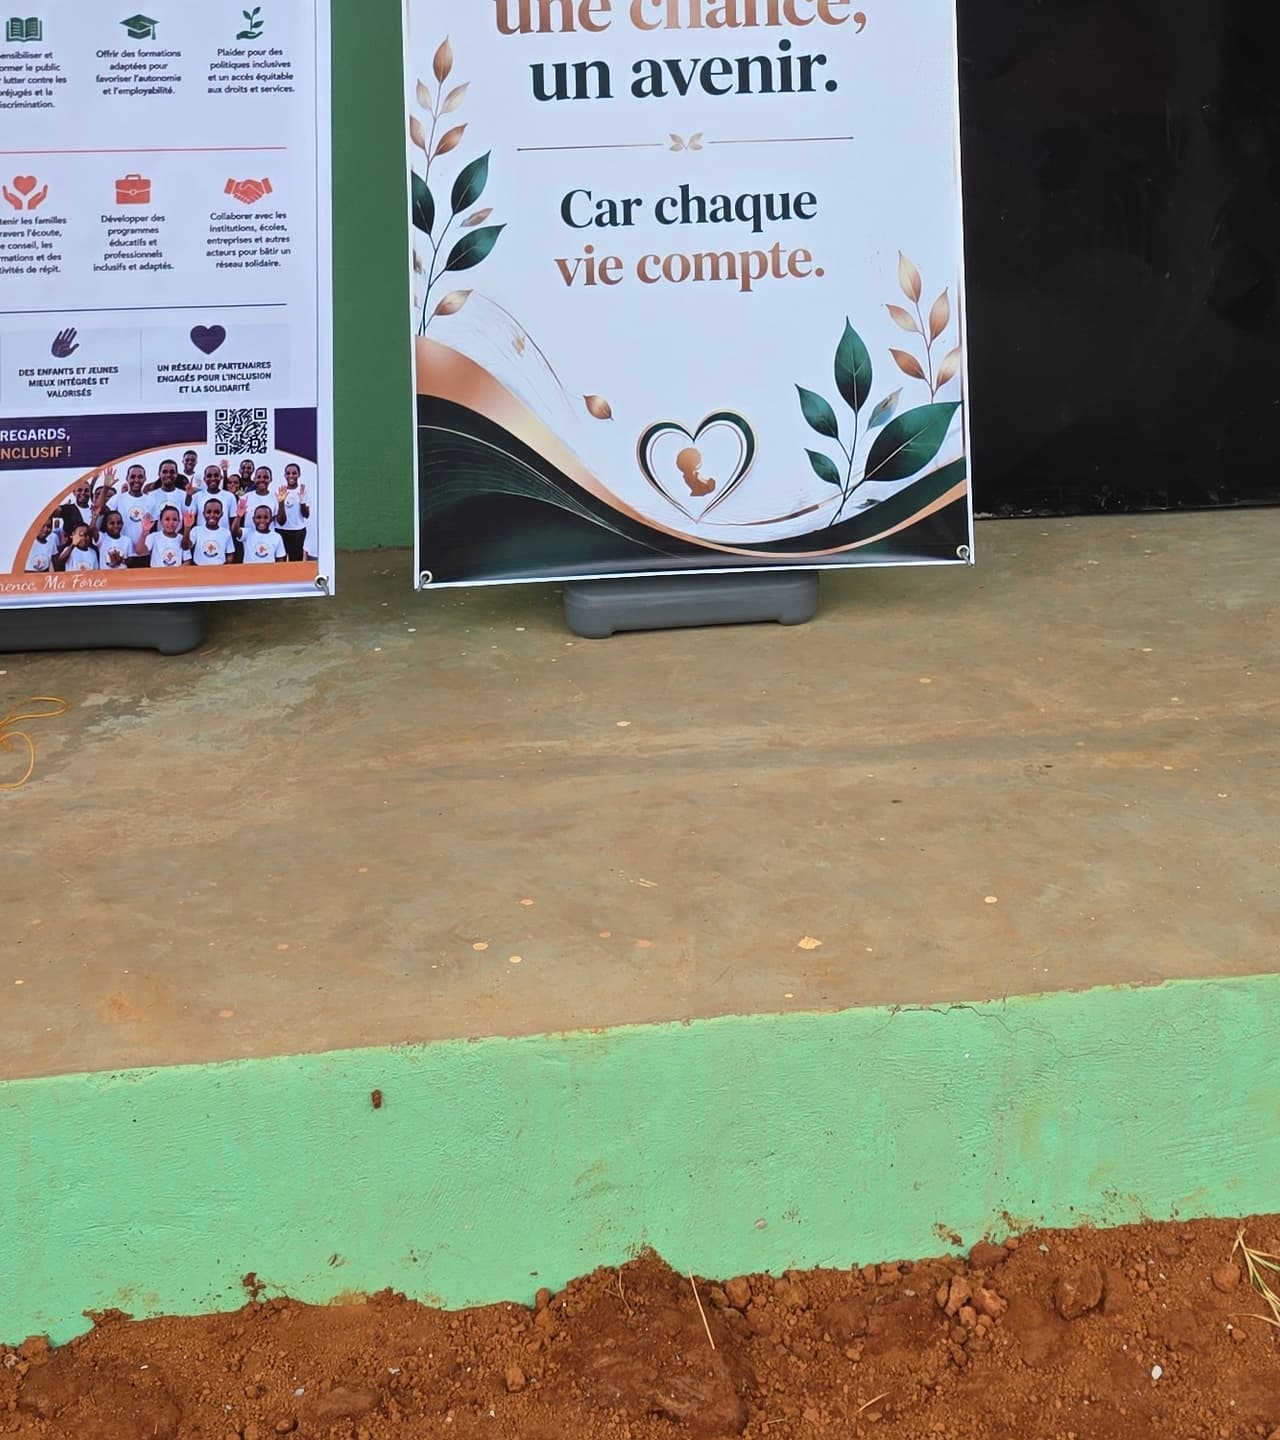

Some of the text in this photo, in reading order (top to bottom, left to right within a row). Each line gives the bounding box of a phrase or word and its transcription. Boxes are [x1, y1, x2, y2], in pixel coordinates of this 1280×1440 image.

[529, 38, 837, 101] un avenir.
[560, 183, 817, 233] Car chaque
[553, 241, 824, 292] vie compte.
[0, 427, 69, 441] REGARDS,
[67, 445, 71, 456] !
[43, 574, 66, 591] Ma
[72, 574, 107, 589] Force
